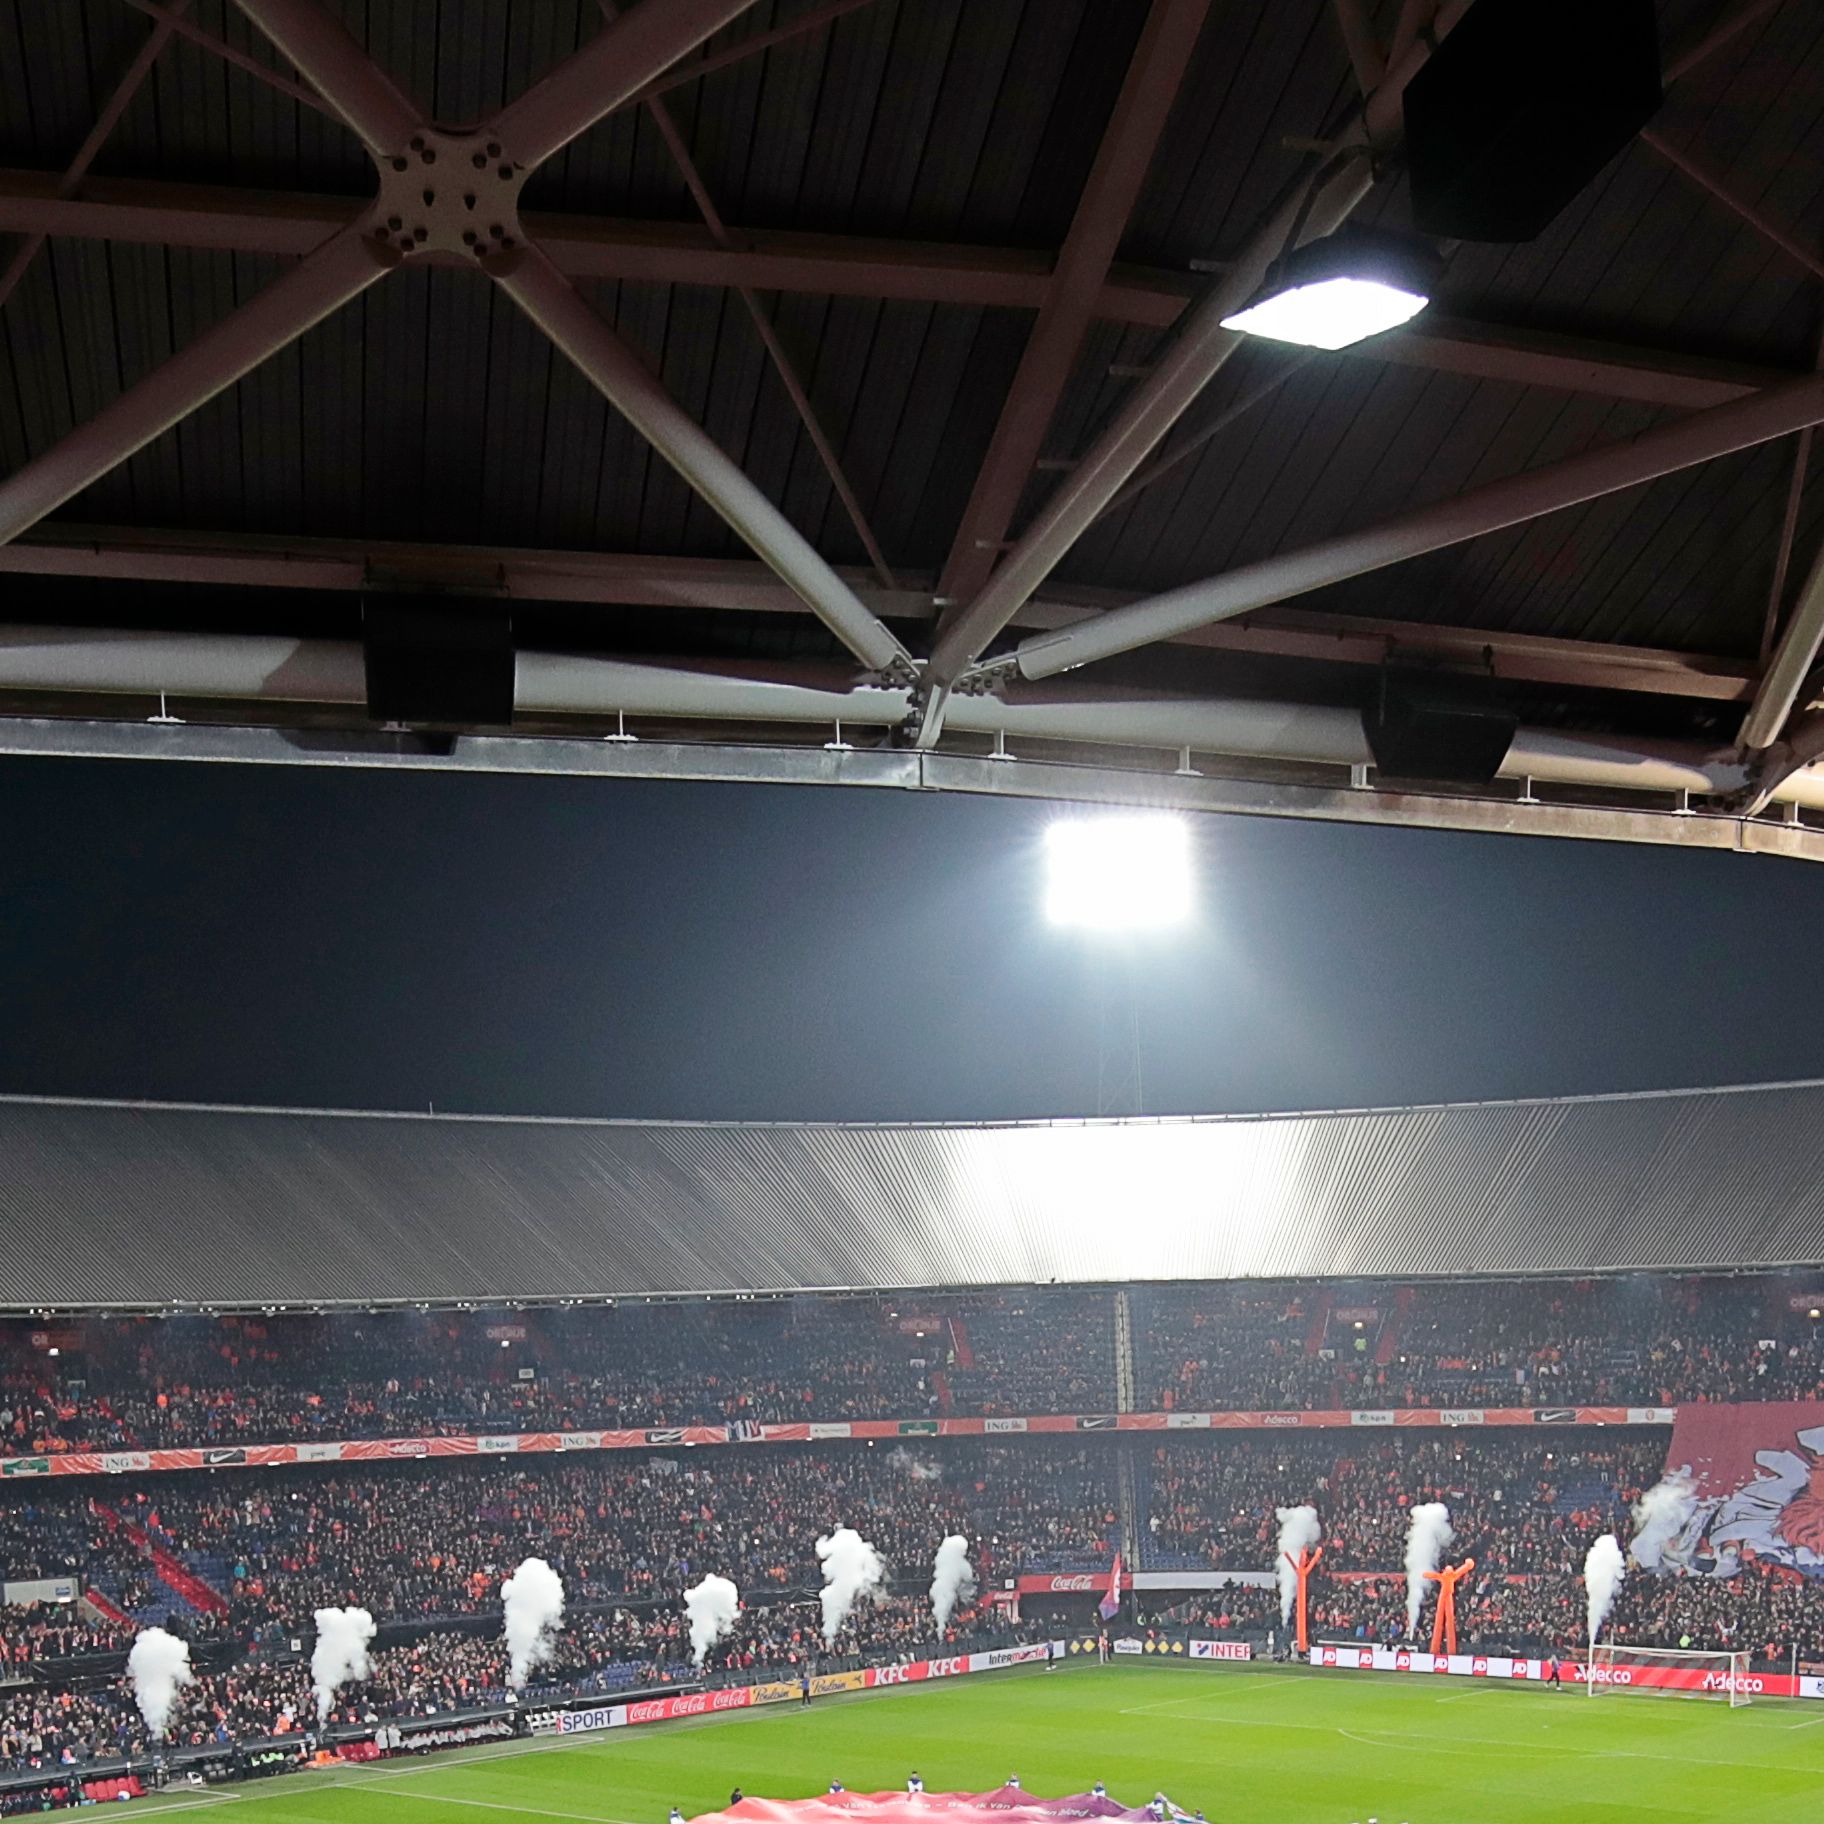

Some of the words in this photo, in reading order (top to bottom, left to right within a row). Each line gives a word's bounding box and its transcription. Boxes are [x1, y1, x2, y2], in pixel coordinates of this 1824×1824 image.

[987, 1421, 1008, 1431] ING
[1444, 1413, 1465, 1422] ING
[564, 1437, 584, 1447] ING
[104, 1458, 130, 1472] ING
[927, 1657, 962, 1677] KFC
[1573, 1664, 1632, 1684] Adecco
[875, 1666, 910, 1686] KFC
[1702, 1672, 1764, 1693] Adecco
